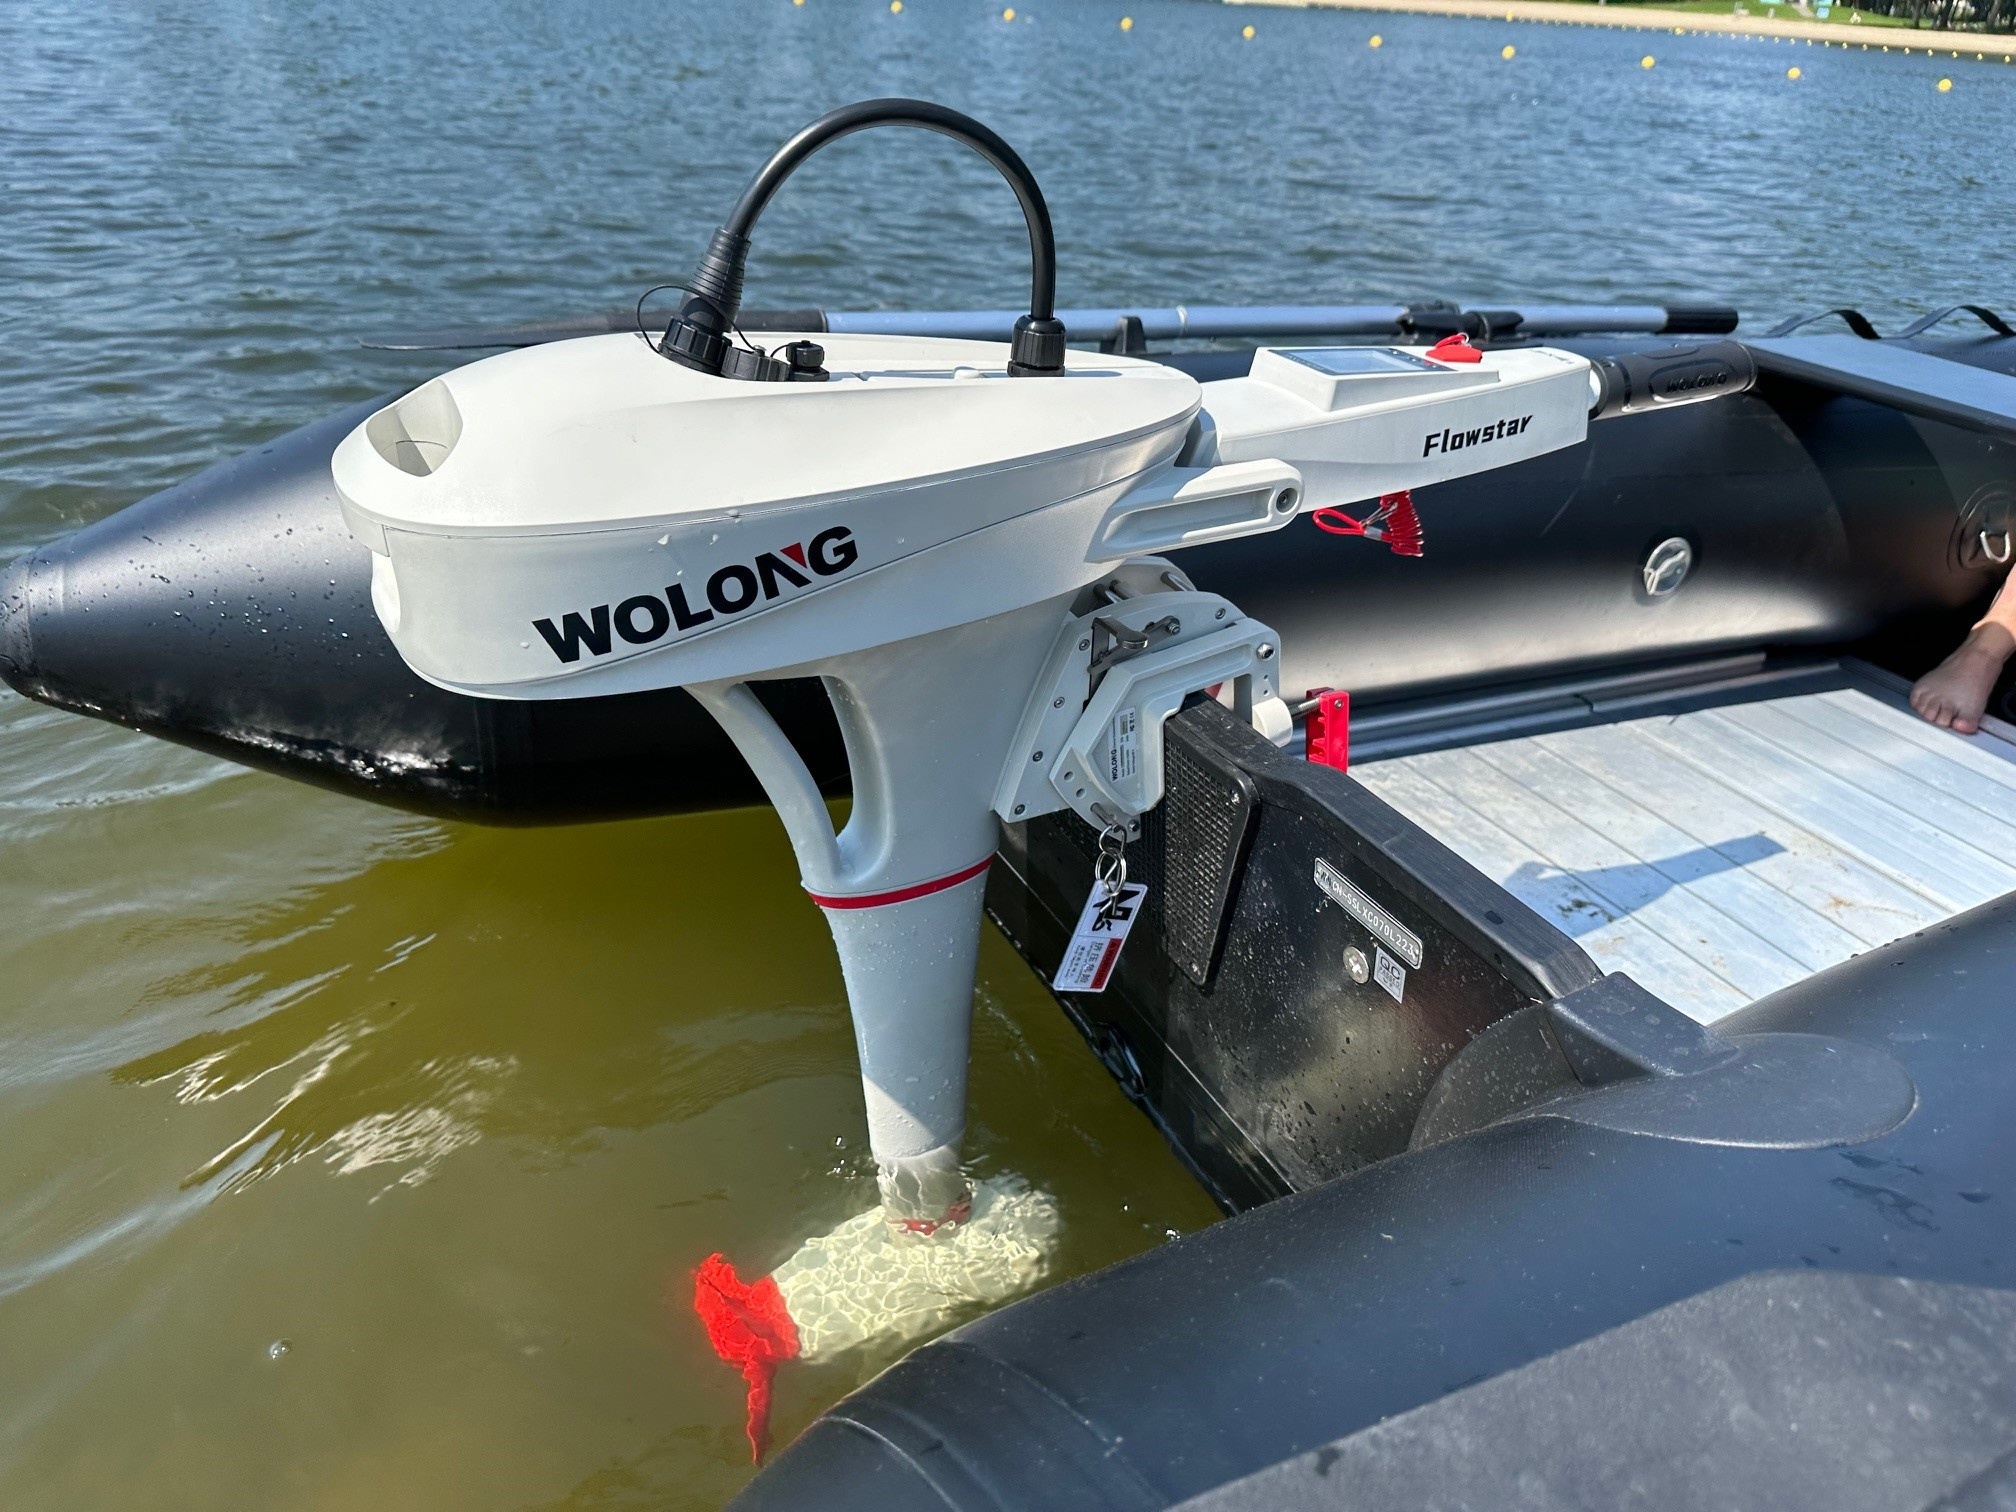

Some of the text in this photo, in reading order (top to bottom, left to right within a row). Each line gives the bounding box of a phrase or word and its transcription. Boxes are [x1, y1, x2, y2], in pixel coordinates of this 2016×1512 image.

[1422, 414, 1534, 458] Flowstar
[532, 525, 859, 664] WOLONG
[1110, 748, 1118, 781] WOLONG
[1380, 956, 1401, 981] QC
